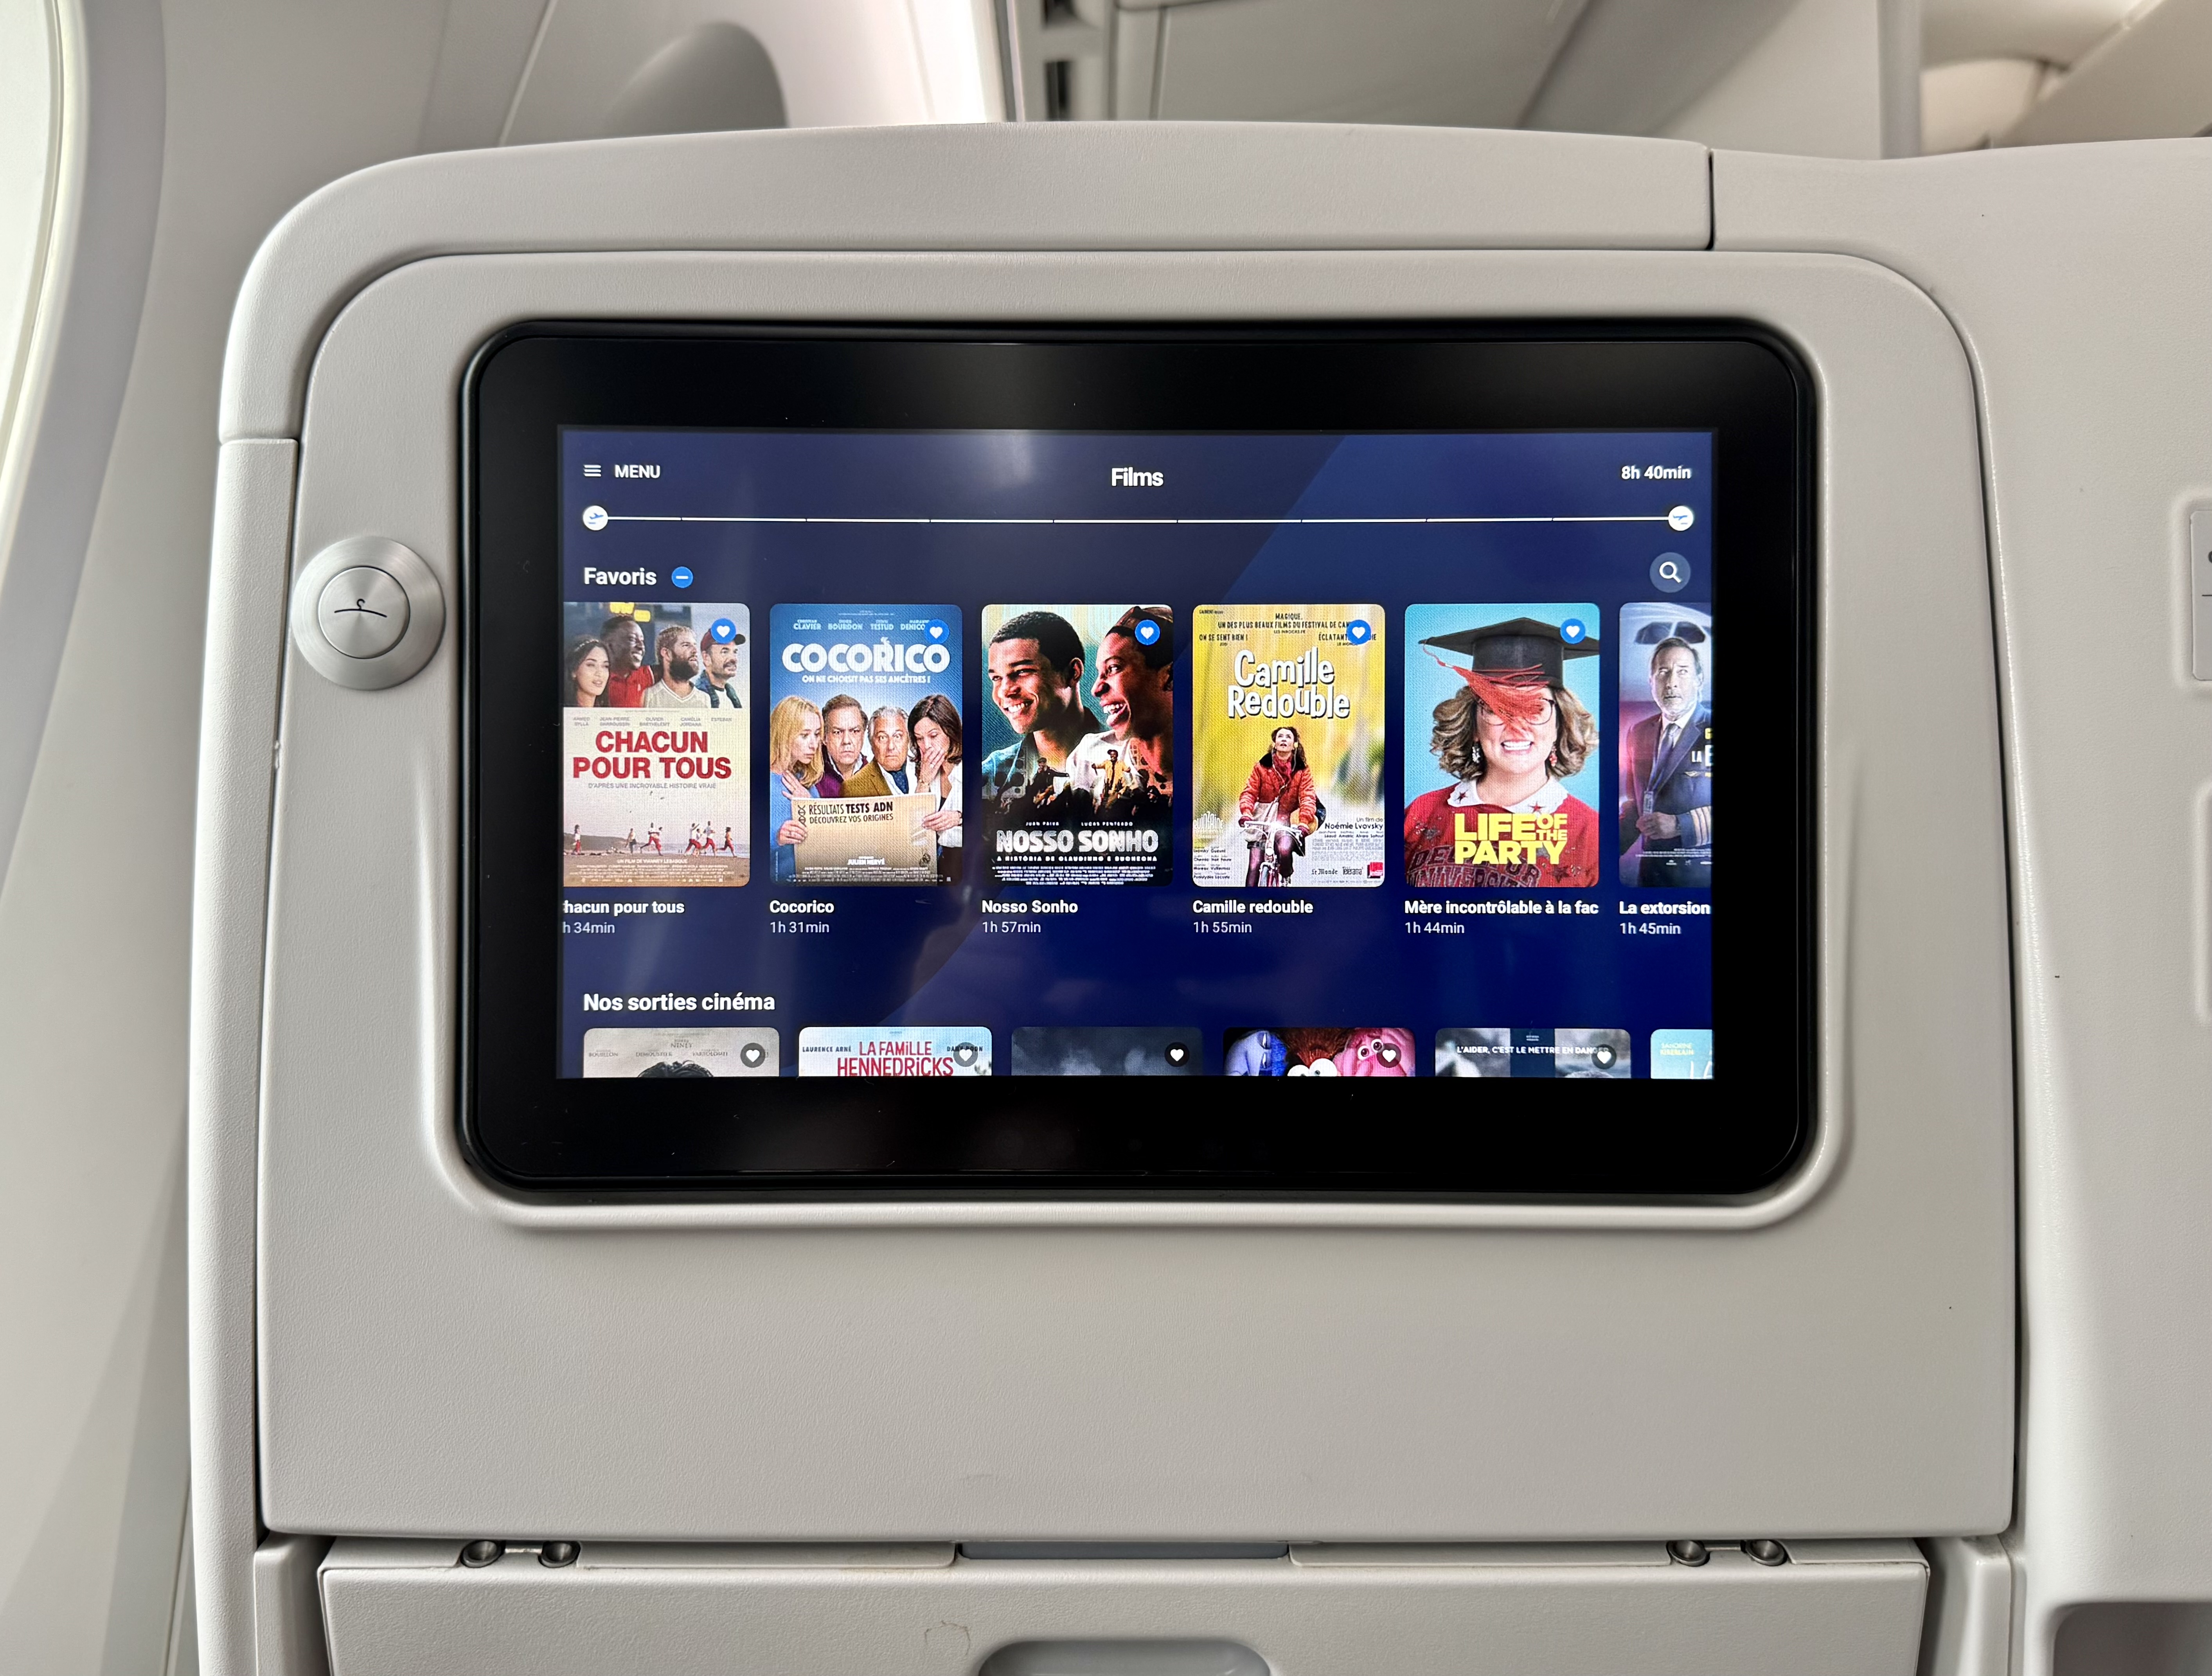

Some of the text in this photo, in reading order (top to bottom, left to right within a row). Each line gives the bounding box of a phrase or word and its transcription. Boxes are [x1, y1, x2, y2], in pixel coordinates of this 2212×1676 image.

[615, 464, 660, 478] MENU
[1111, 467, 1164, 486] Films
[1621, 465, 1692, 480] 8h 40min
[584, 567, 657, 585] Favoris
[1318, 631, 1347, 641] ÉCLATANT
[782, 643, 950, 673] COCORICO
[1234, 646, 1335, 688] Camille
[802, 675, 815, 683] ON
[816, 675, 826, 683] NE
[827, 675, 858, 683] CHOISIT
[860, 675, 874, 683] PAS
[875, 675, 887, 683] SES
[888, 673, 926, 683] ANCÊTRES
[1227, 685, 1351, 719] Redouble
[595, 730, 708, 753] CHACUN
[1692, 750, 1702, 762] LA
[573, 757, 732, 779] POUR TOUS
[809, 802, 893, 815] RÉSULTATS TESTS ADN
[809, 816, 847, 824] DÉCOUVREZ
[863, 813, 894, 822] ORIGINES
[1536, 814, 1568, 829] OF
[1455, 813, 1536, 841] LIFE
[996, 830, 1159, 853] NOSSO SONHO
[1536, 829, 1568, 841] THE
[1455, 841, 1567, 865] PARTY
[563, 900, 685, 916] hacun pour tous
[770, 900, 834, 913] Cocorico
[982, 899, 1078, 913] Nosso Sonho
[1192, 900, 1314, 914] Camille redouble
[1405, 900, 1599, 914] Mère incontrôlable à la fac
[1619, 901, 1711, 914] La extorsion
[574, 921, 615, 933] 34min
[770, 922, 830, 933] 1h 31min
[982, 921, 1041, 933] 1h 57min
[1193, 921, 1253, 933] 1h 55min
[1405, 922, 1465, 933] 1h 44min
[1620, 922, 1681, 934] 1h 45min
[583, 992, 775, 1011] Nos sorties cinéma
[859, 1041, 876, 1056] LA
[1457, 1046, 1490, 1054] L'AIDER,
